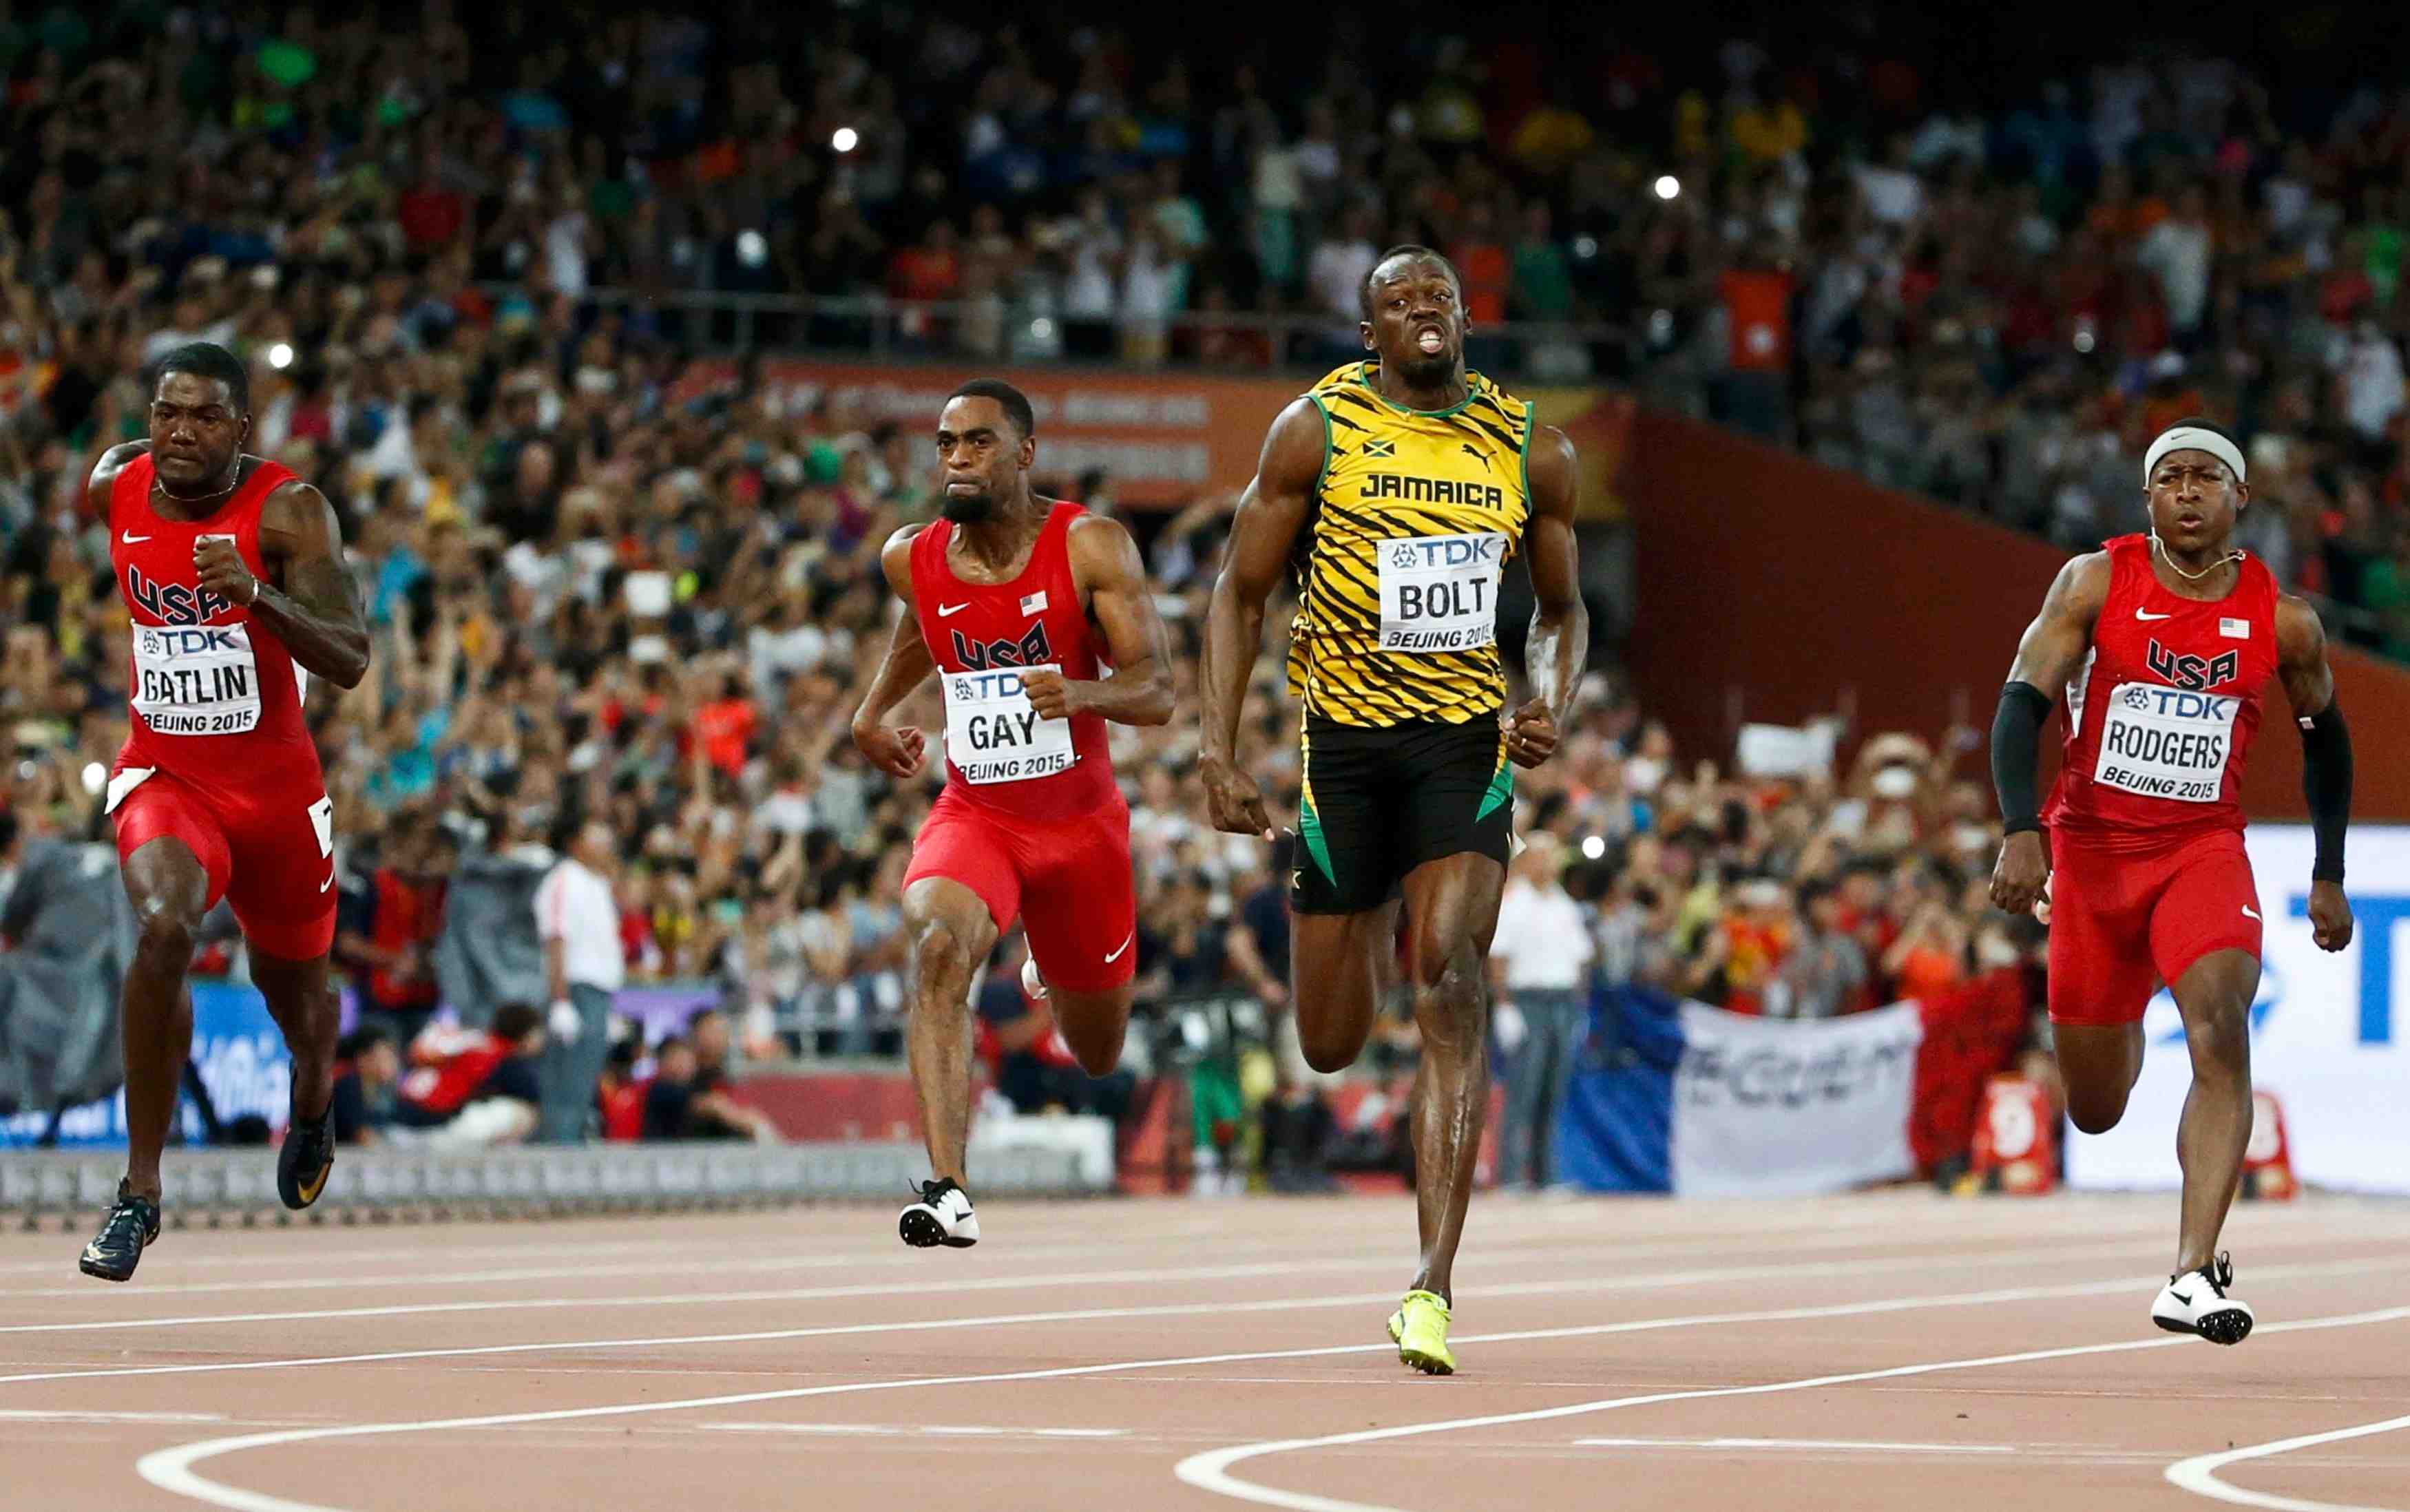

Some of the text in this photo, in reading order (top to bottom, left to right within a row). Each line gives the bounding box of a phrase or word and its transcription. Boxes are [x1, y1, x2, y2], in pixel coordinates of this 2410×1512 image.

[1361, 474, 1503, 512] JAMAICA
[1416, 537, 1496, 567] TDK
[129, 563, 231, 627] USA
[1398, 577, 1487, 620] BOLT
[157, 630, 240, 656] TDK
[950, 618, 1052, 671] USA
[1387, 630, 1462, 648] BEIJING
[2146, 637, 2238, 691] USA
[143, 664, 249, 704] GATLIN
[971, 672, 1025, 700] TD
[211, 710, 253, 731] 2015
[2152, 690, 2230, 721] TDK
[968, 711, 1036, 750] GAY
[2107, 720, 2223, 770] RODGERS
[1024, 753, 1065, 775] 2015
[2103, 766, 2216, 799] BEIJING 2015
